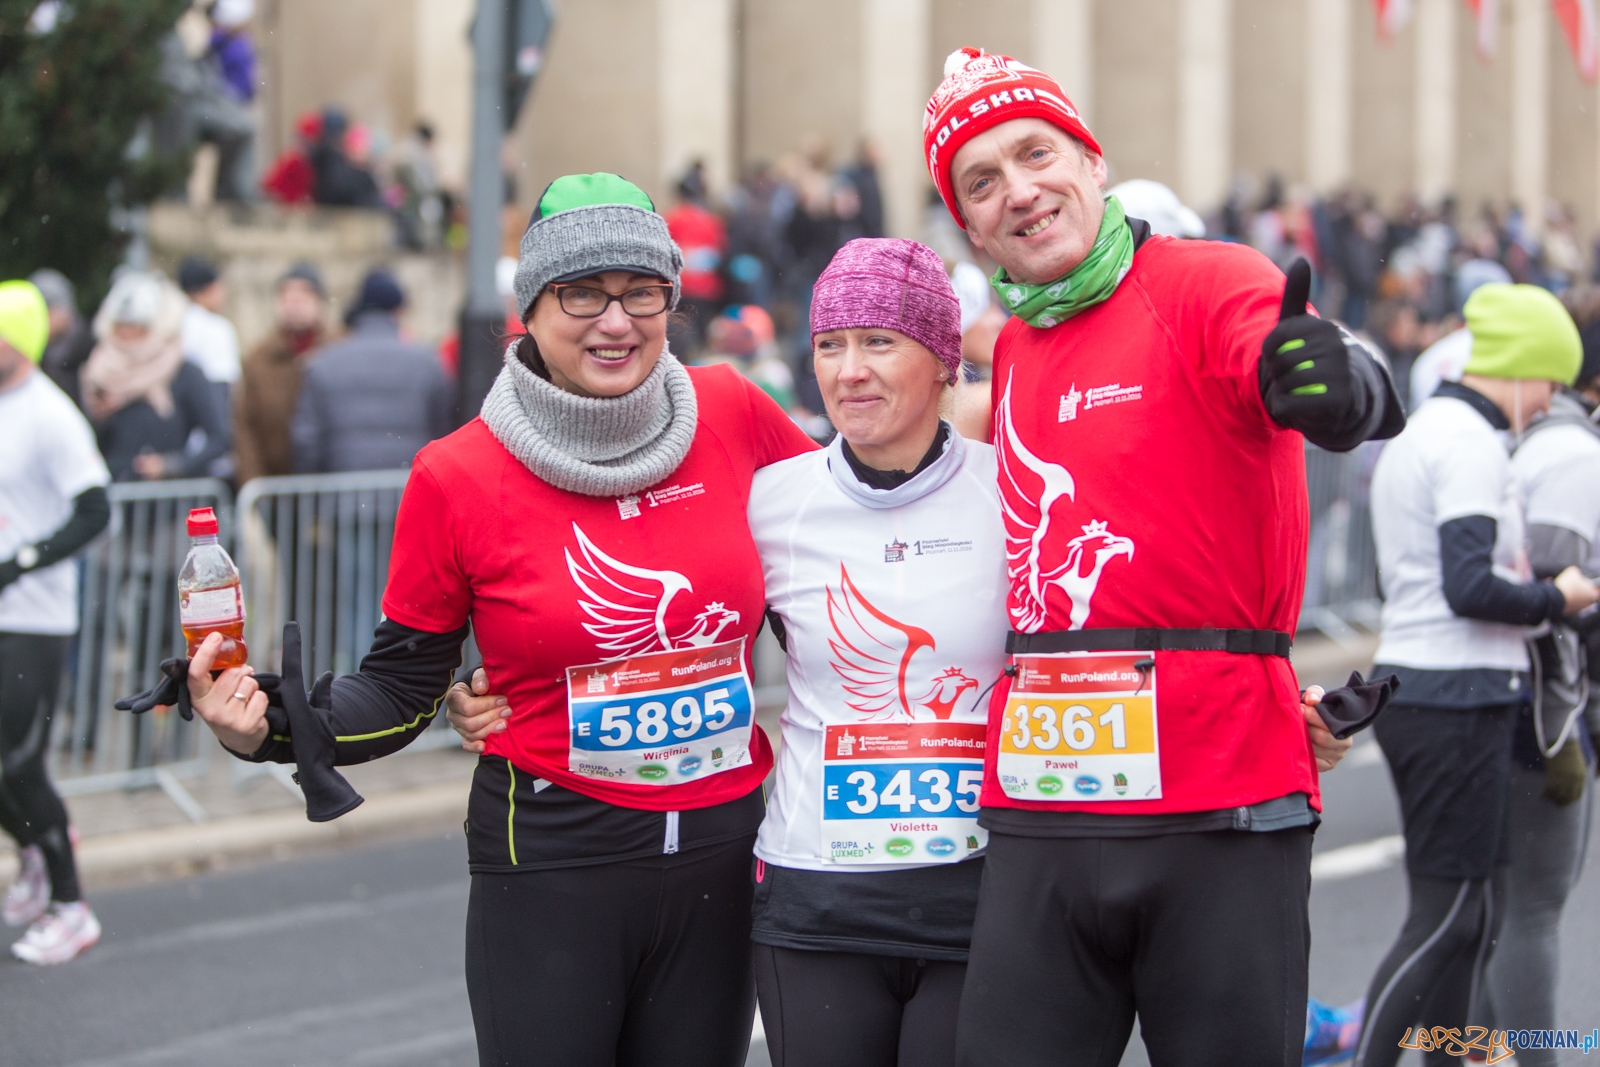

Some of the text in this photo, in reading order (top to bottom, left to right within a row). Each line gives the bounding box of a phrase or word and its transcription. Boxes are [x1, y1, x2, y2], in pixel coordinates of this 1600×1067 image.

[930, 87, 1036, 165] POLSKA
[1083, 388, 1093, 410] 1
[645, 491, 659, 507] 1
[913, 540, 924, 556] 1
[671, 656, 732, 677] RunPoland.org
[611, 671, 621, 687] 1
[1060, 671, 1139, 683] RunPoland.org
[577, 687, 735, 747] E 5895
[1012, 703, 1127, 751] 3361
[858, 735, 867, 751] 1
[920, 737, 986, 749] RunPoland.or
[643, 746, 690, 761] Wirginia
[578, 768, 614, 777] LUXMED
[579, 763, 609, 771] GRUPA
[1045, 760, 1078, 769] Paweł
[827, 769, 983, 814] E 3435
[890, 823, 938, 832] Violetta
[831, 841, 858, 849] GRUPA
[831, 849, 864, 858] LUXMED
